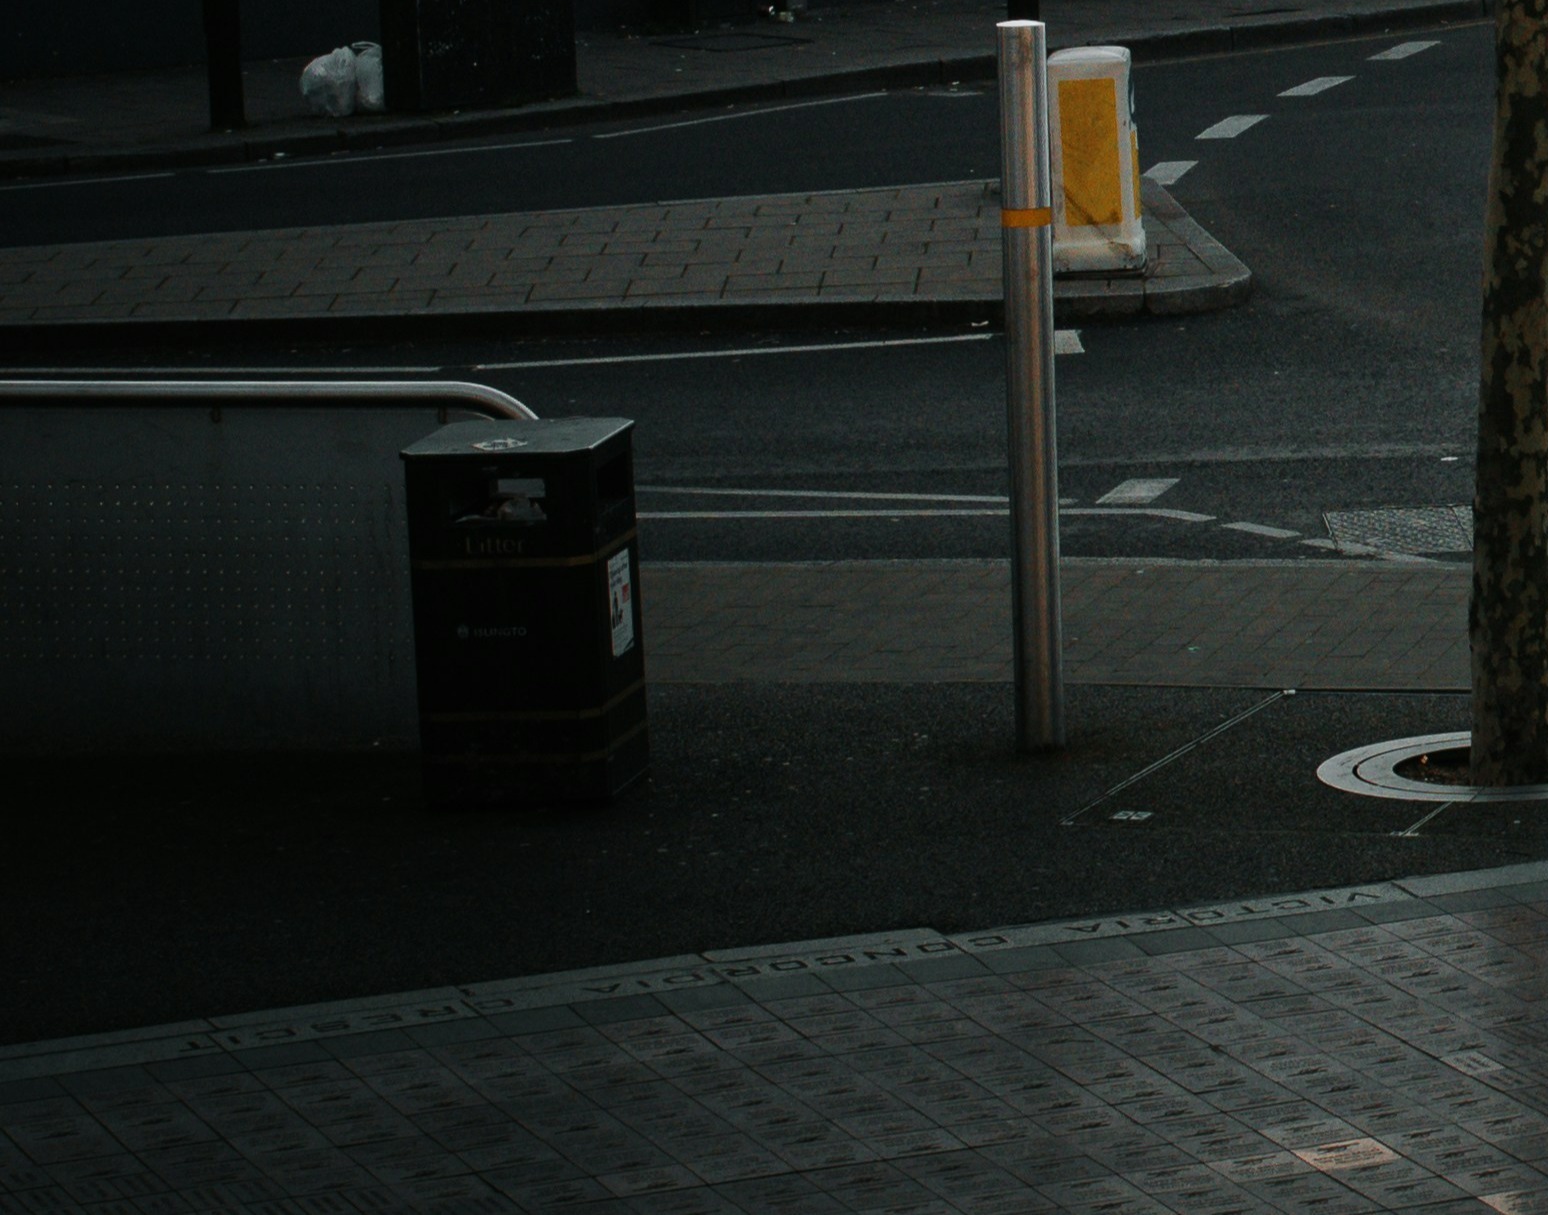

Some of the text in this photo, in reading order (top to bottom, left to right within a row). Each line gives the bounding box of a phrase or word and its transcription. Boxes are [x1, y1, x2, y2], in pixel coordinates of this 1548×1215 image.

[465, 535, 525, 555] Litter
[179, 891, 1381, 1054] VICTORIA CONCORDIA CRESCIT
